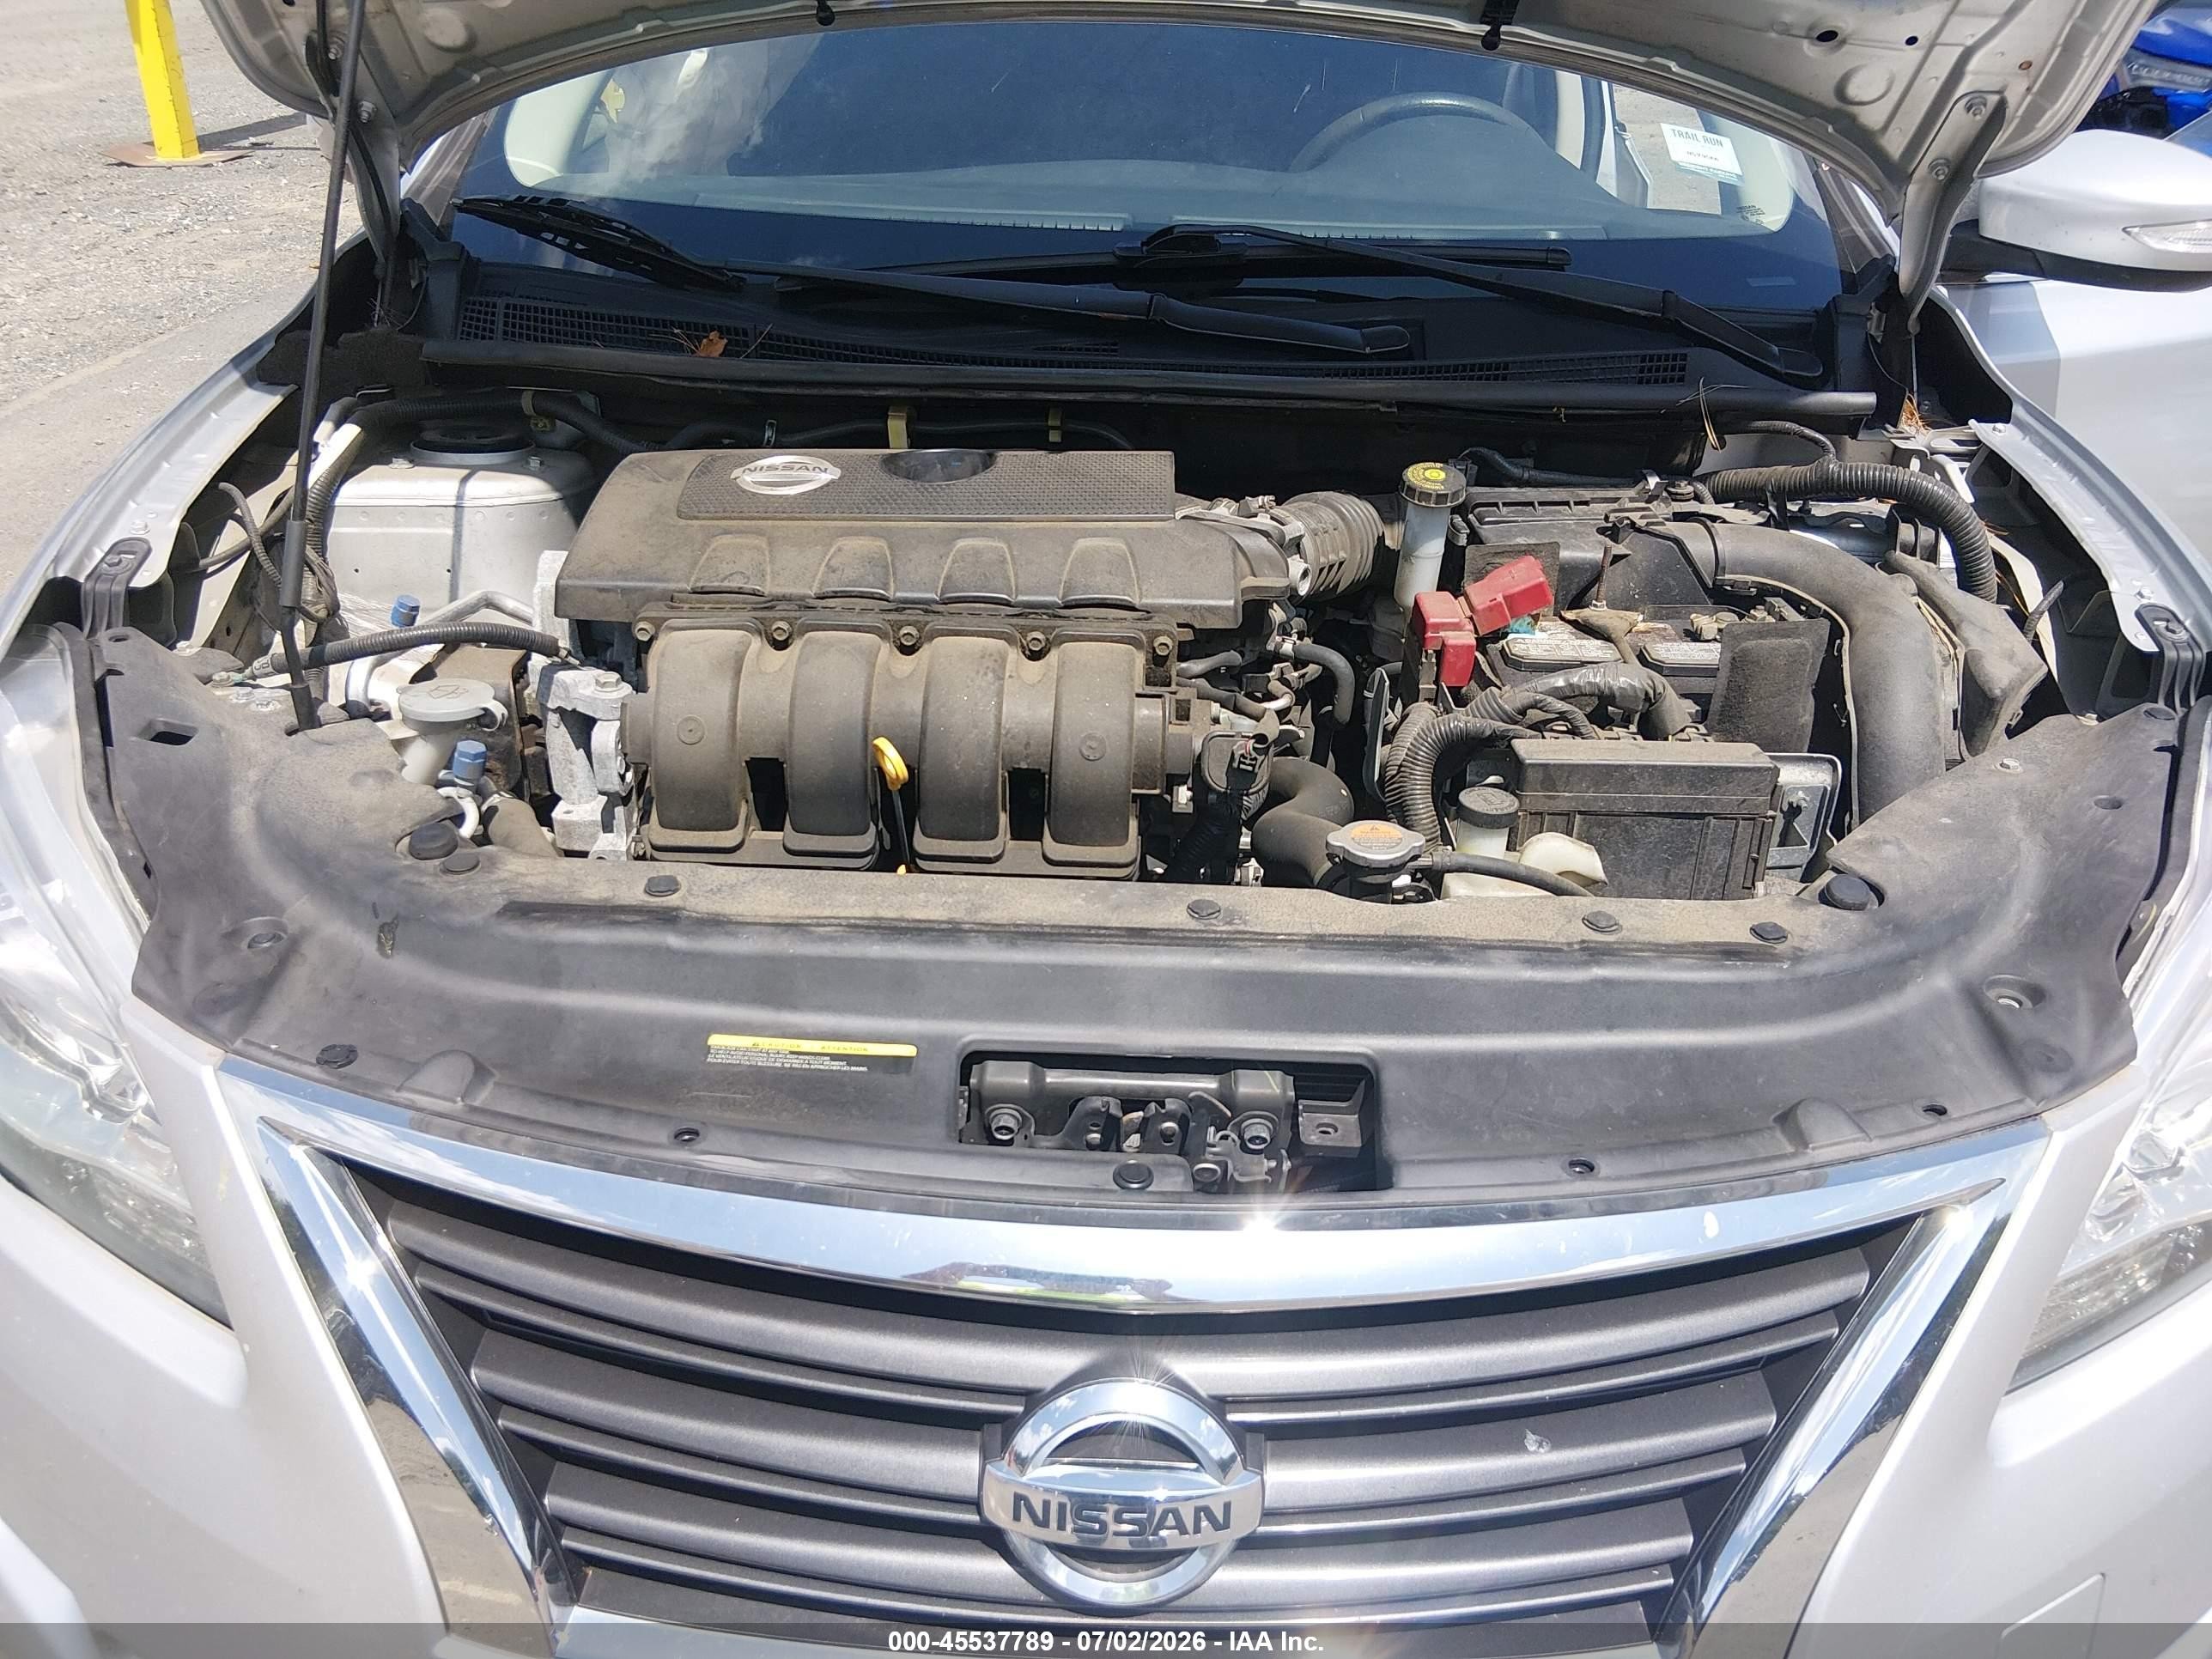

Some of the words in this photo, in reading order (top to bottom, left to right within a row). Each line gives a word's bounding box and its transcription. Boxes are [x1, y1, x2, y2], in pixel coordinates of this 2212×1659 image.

[1670, 128, 1701, 143] TRAIL
[1702, 135, 1723, 148] RUN
[742, 465, 828, 474] NISSAN
[1012, 1492, 1231, 1537] NISSAN
